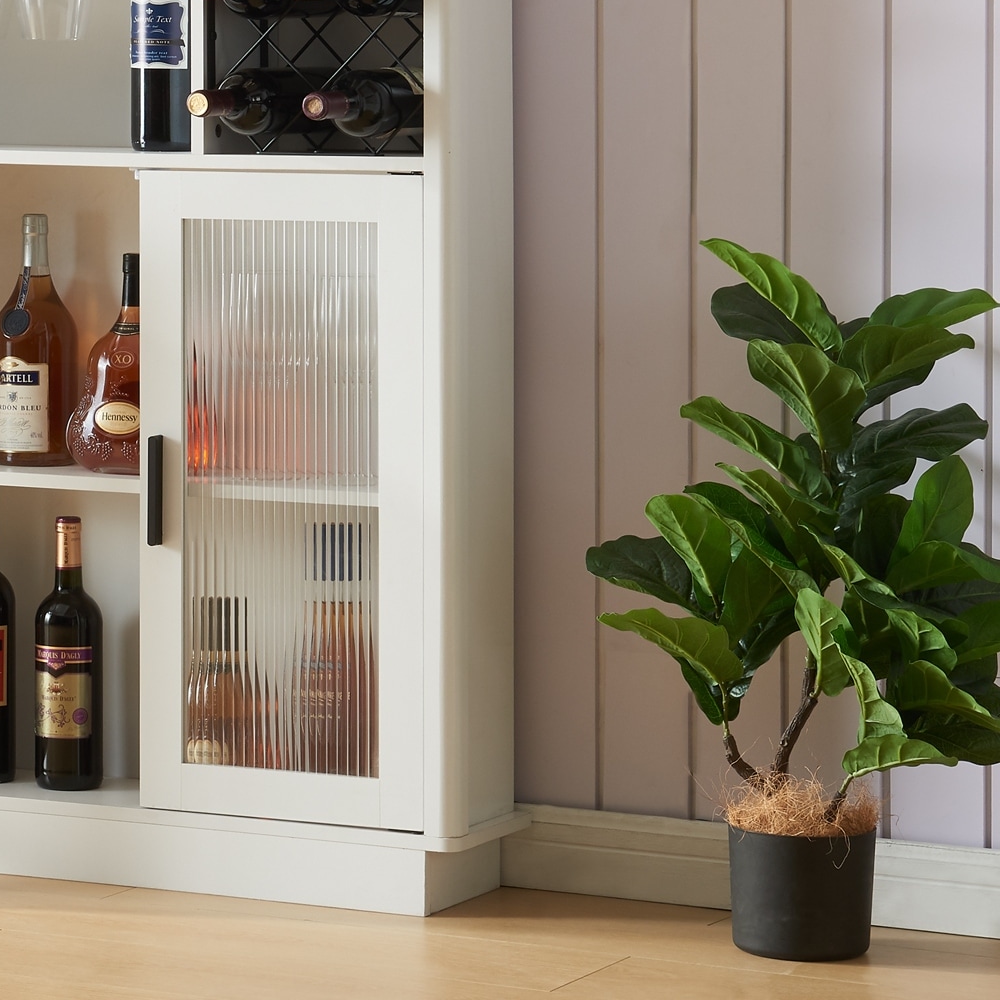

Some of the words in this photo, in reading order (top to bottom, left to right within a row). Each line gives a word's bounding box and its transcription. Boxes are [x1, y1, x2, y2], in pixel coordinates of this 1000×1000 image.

[133, 15, 154, 23] Sple
[156, 15, 172, 23] Text
[102, 411, 139, 424] Hennessy
